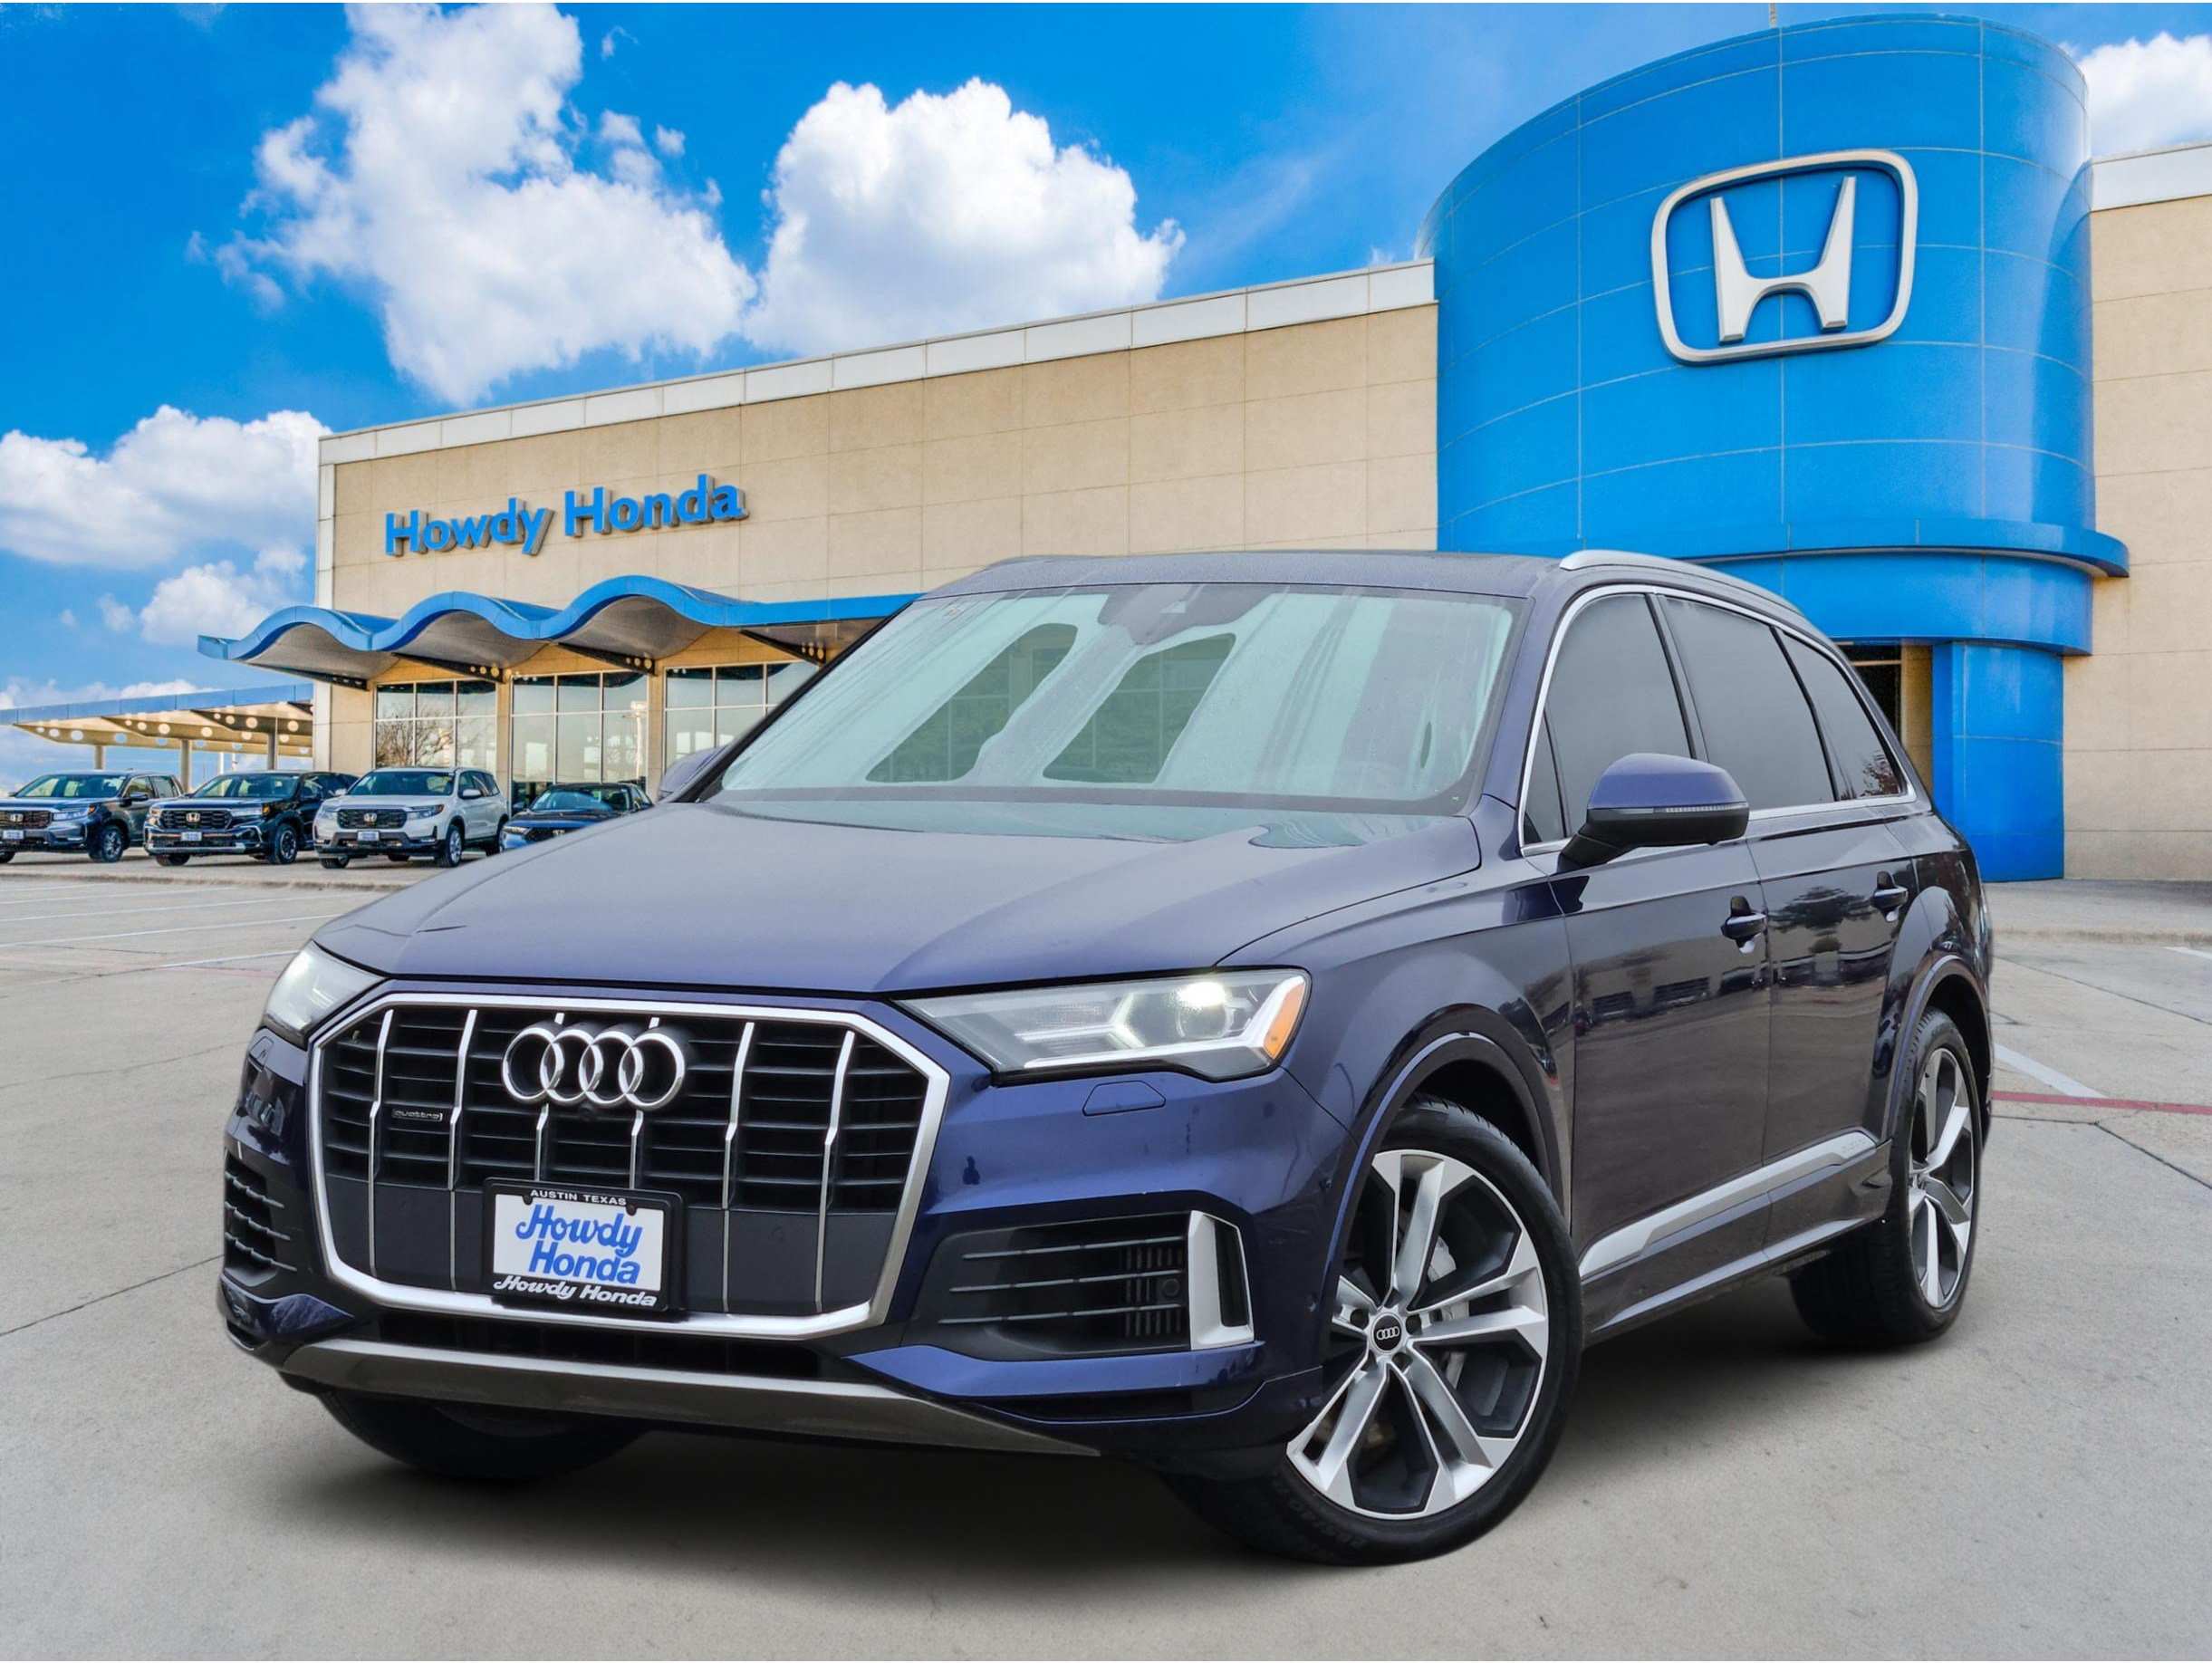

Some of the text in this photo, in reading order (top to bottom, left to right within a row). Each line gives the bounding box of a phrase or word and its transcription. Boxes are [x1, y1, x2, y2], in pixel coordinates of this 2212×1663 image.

[385, 474, 750, 557] Howdy Honda
[530, 1189, 627, 1206] AUSTIN TEXAS
[515, 1203, 644, 1258] Howdy
[528, 1240, 641, 1284] Honda
[493, 1274, 658, 1307] Howdy Honda
